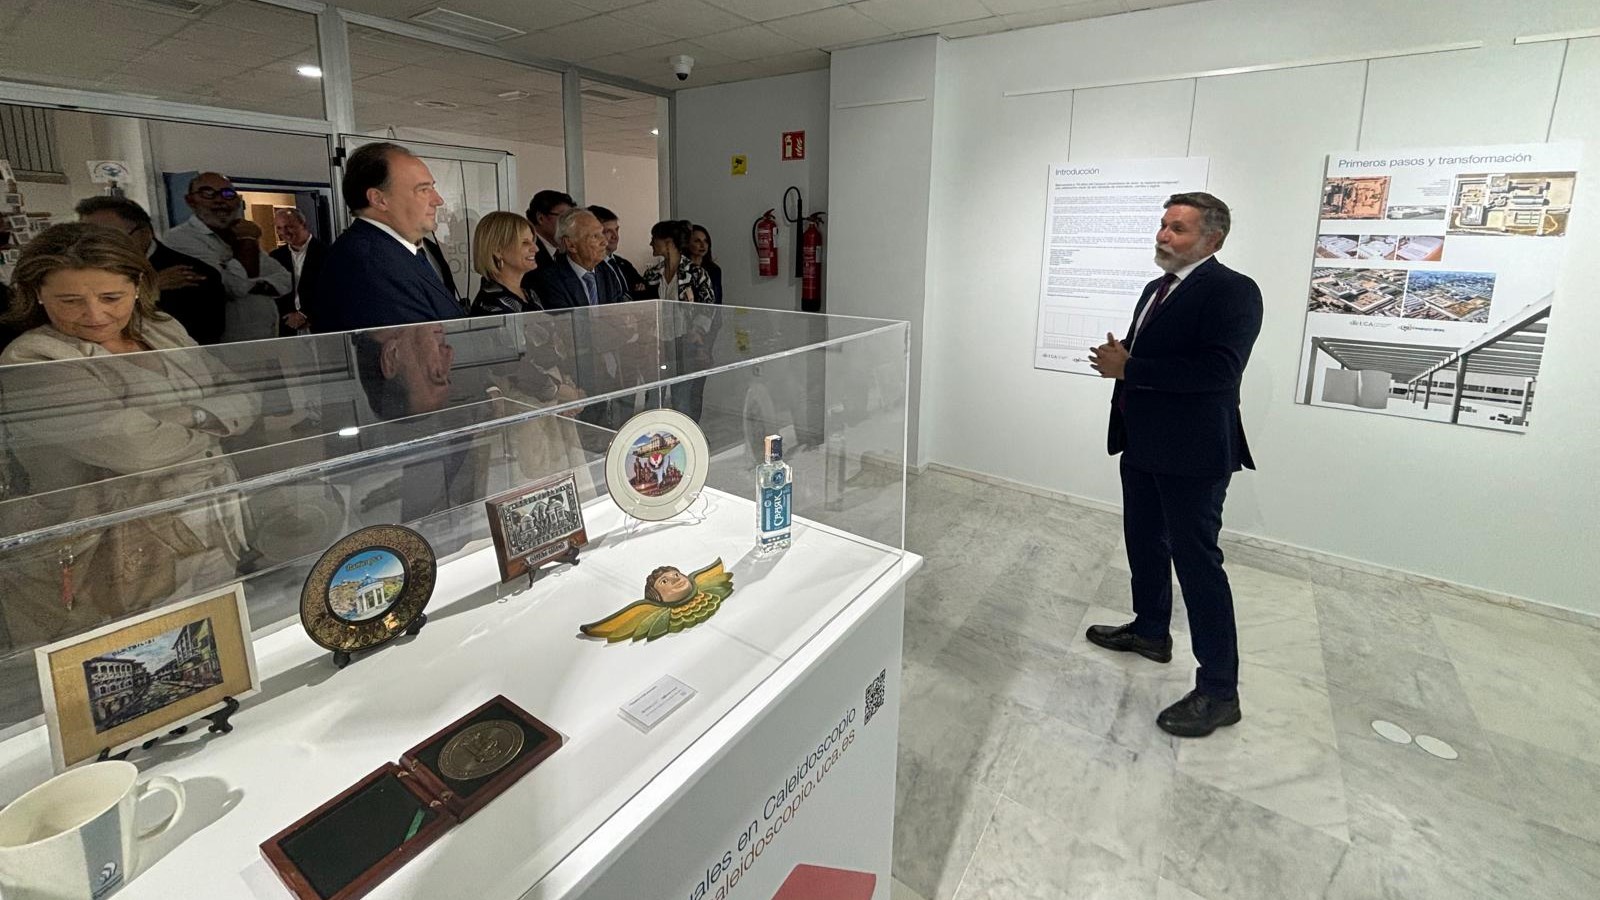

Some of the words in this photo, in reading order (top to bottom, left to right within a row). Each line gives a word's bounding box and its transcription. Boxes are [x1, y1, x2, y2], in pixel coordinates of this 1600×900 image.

[1055, 167, 1100, 176] Introducción
[1338, 159, 1387, 169] Primeros
[1389, 157, 1425, 168] pasos
[1427, 157, 1436, 167] y
[1438, 153, 1533, 166] transformación
[710, 729, 856, 900] aleidoscopio.uca.es
[738, 819, 758, 852] en
[763, 707, 856, 821] Caleidoscopio
